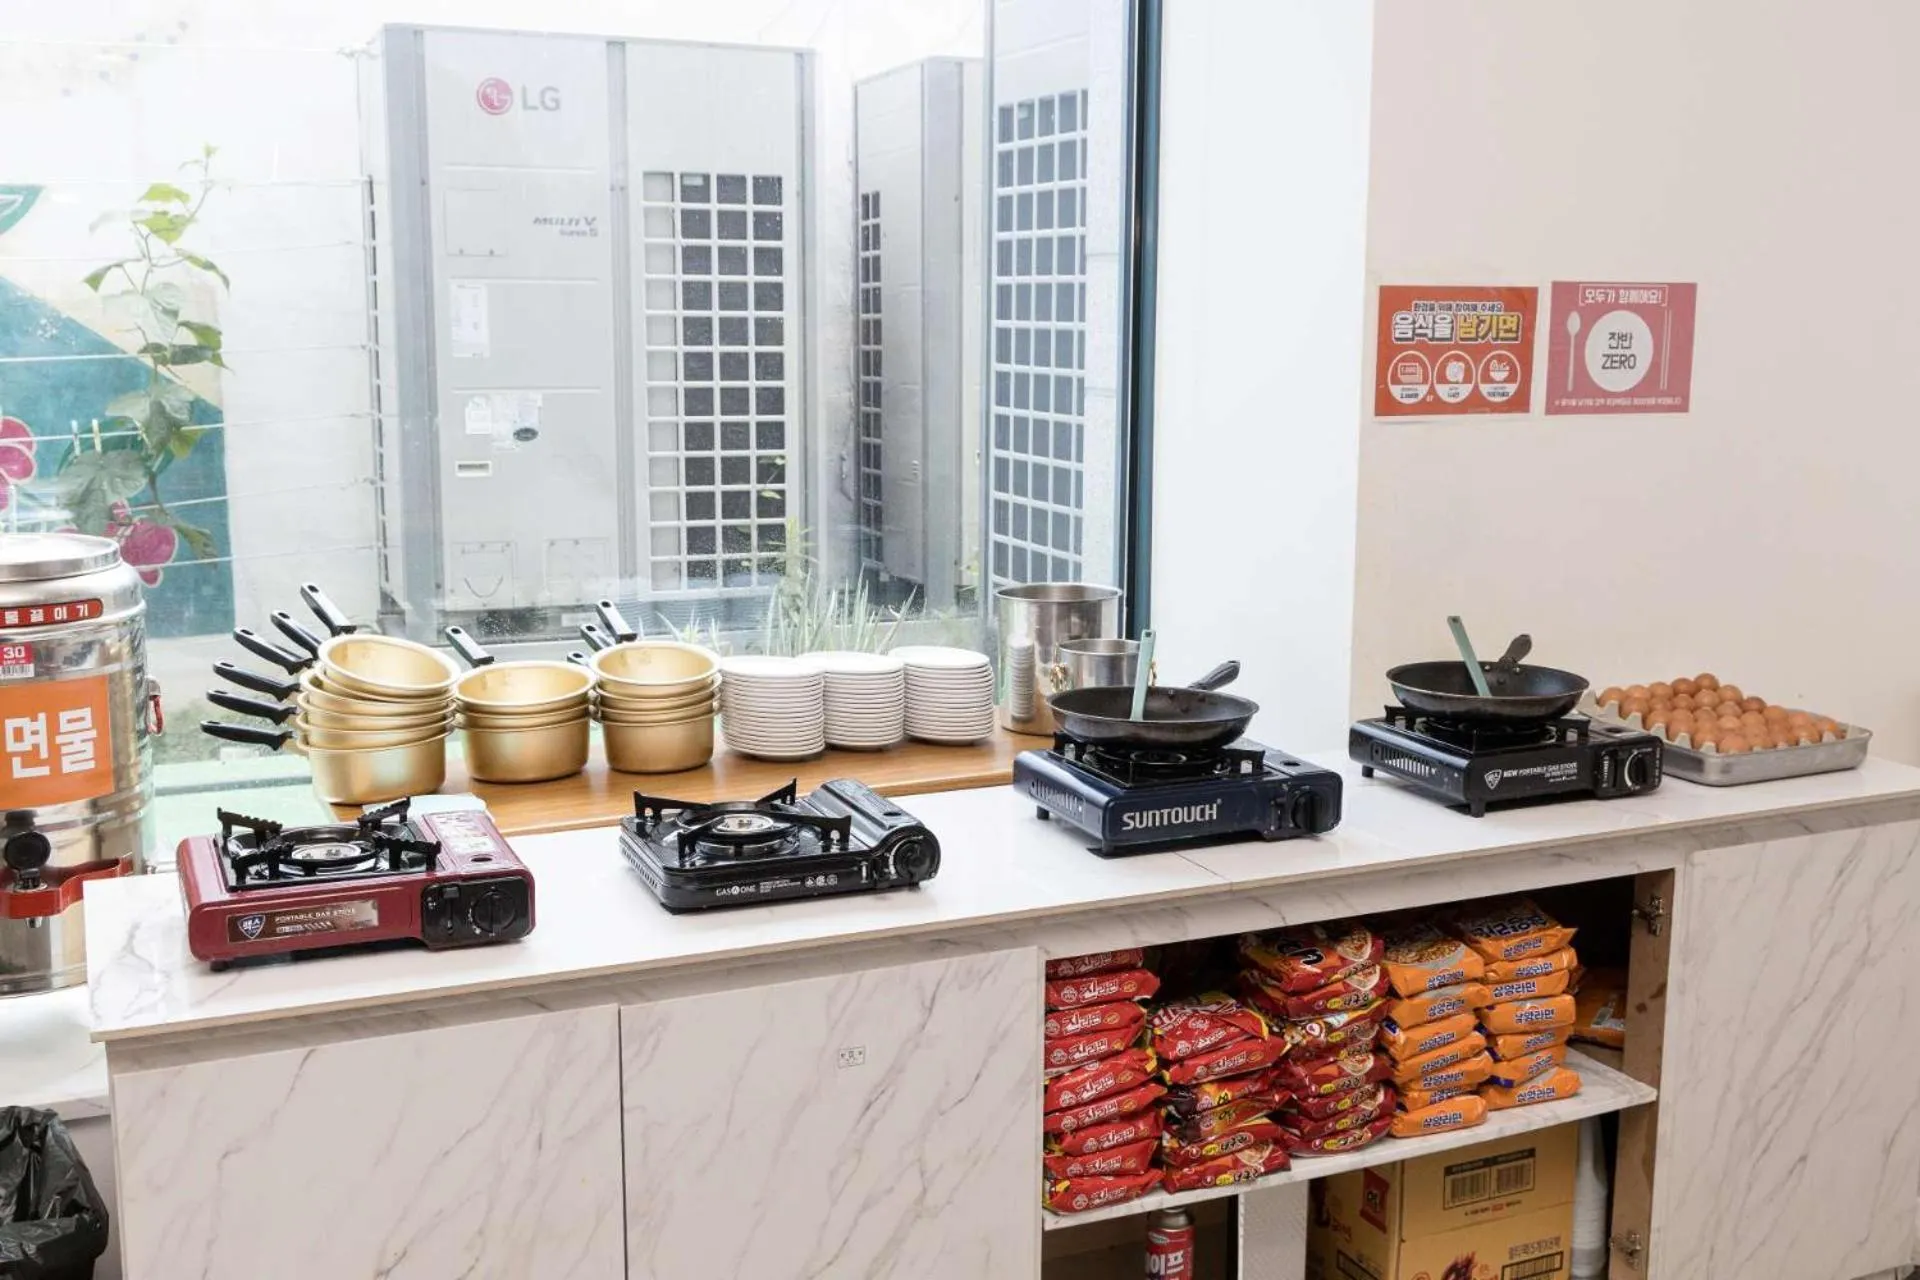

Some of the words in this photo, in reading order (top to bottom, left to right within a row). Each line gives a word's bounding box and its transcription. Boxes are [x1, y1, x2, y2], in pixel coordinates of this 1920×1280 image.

[522, 85, 561, 111] LG
[1584, 288, 1616, 304] 모두가
[1393, 312, 1454, 342] 음식을
[1458, 312, 1521, 342] 남기면
[1608, 331, 1633, 350] 잔반
[1601, 353, 1637, 370] ZERO
[3, 645, 25, 659] 30
[1122, 803, 1217, 831] SUNTOUCH
[1493, 981, 1537, 998] 삼양라면
[1515, 1008, 1555, 1025] 삼양라면
[1423, 1111, 1463, 1128] 삼양라면
